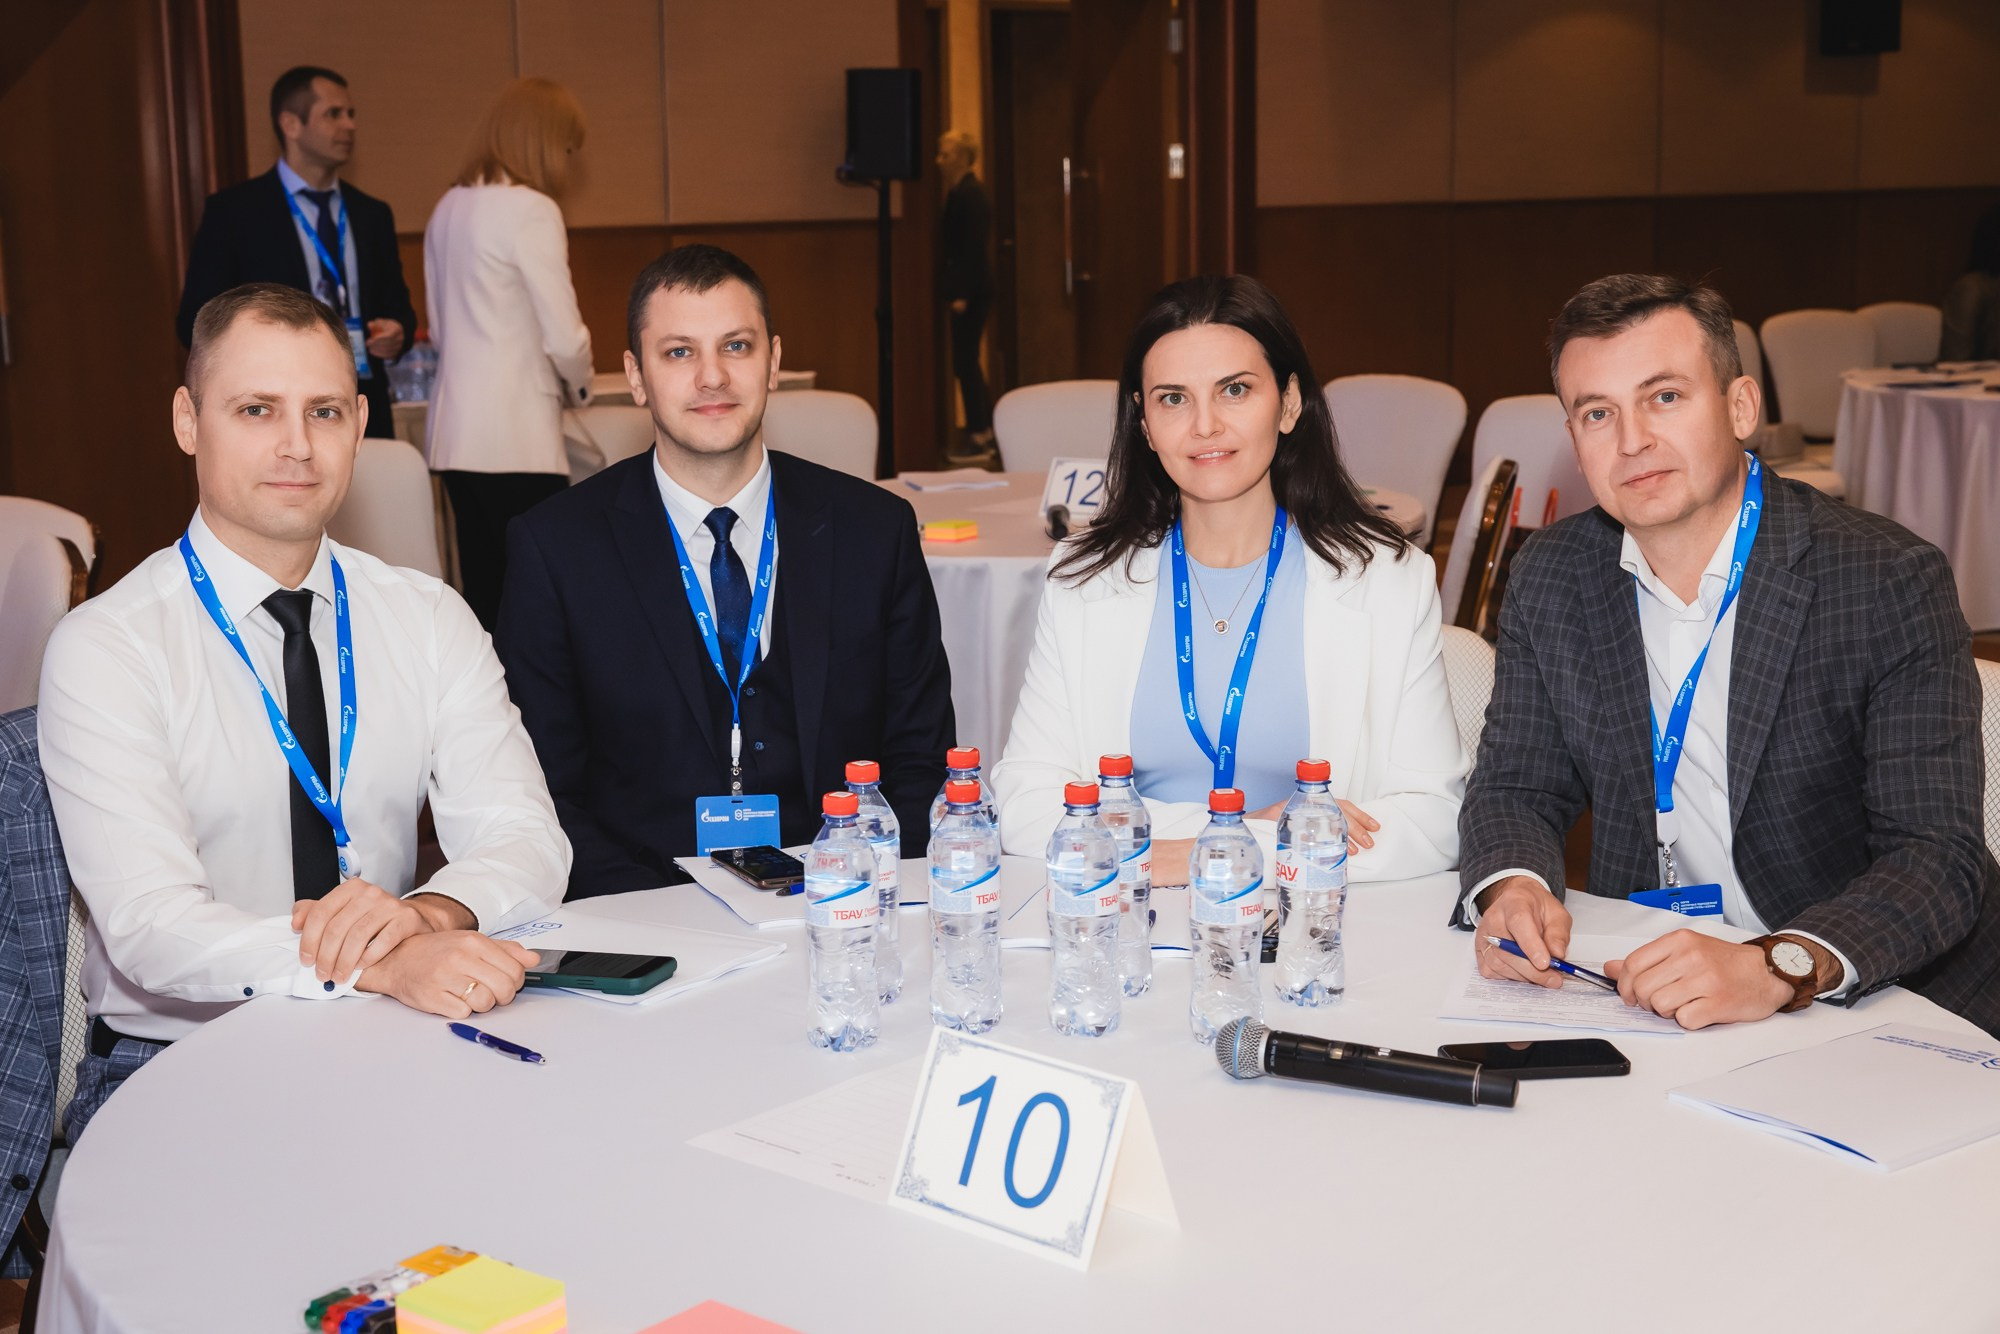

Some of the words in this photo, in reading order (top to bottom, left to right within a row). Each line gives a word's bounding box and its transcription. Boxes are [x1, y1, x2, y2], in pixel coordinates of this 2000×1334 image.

[1063, 469, 1105, 507] 12
[1276, 861, 1298, 881] БАУ
[976, 892, 998, 904] ТБАУ
[833, 909, 863, 920] ТБАУ
[957, 1074, 1070, 1209] 10
